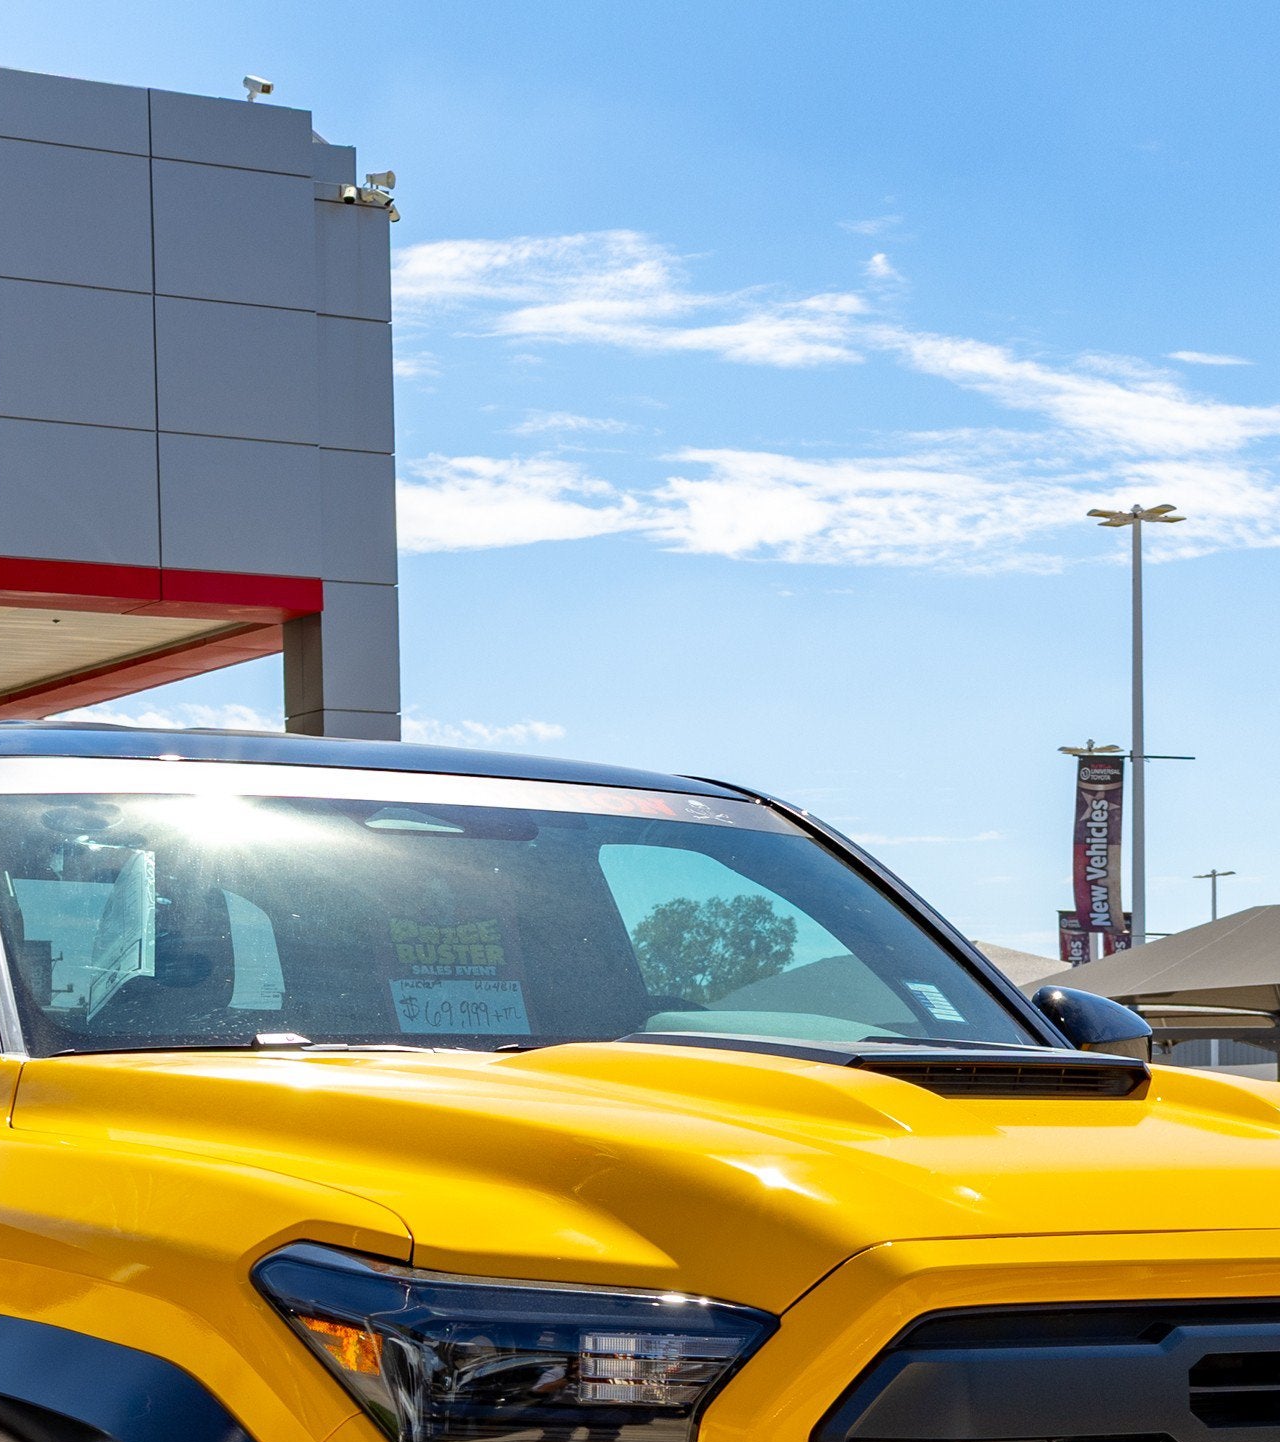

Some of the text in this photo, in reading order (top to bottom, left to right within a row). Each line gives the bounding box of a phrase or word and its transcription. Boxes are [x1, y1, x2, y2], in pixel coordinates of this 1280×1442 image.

[1086, 799, 1112, 926] New Vehicles
[389, 918, 502, 944] PRICE
[396, 944, 506, 965] BUSTER
[412, 966, 496, 976] SALES EVENT
